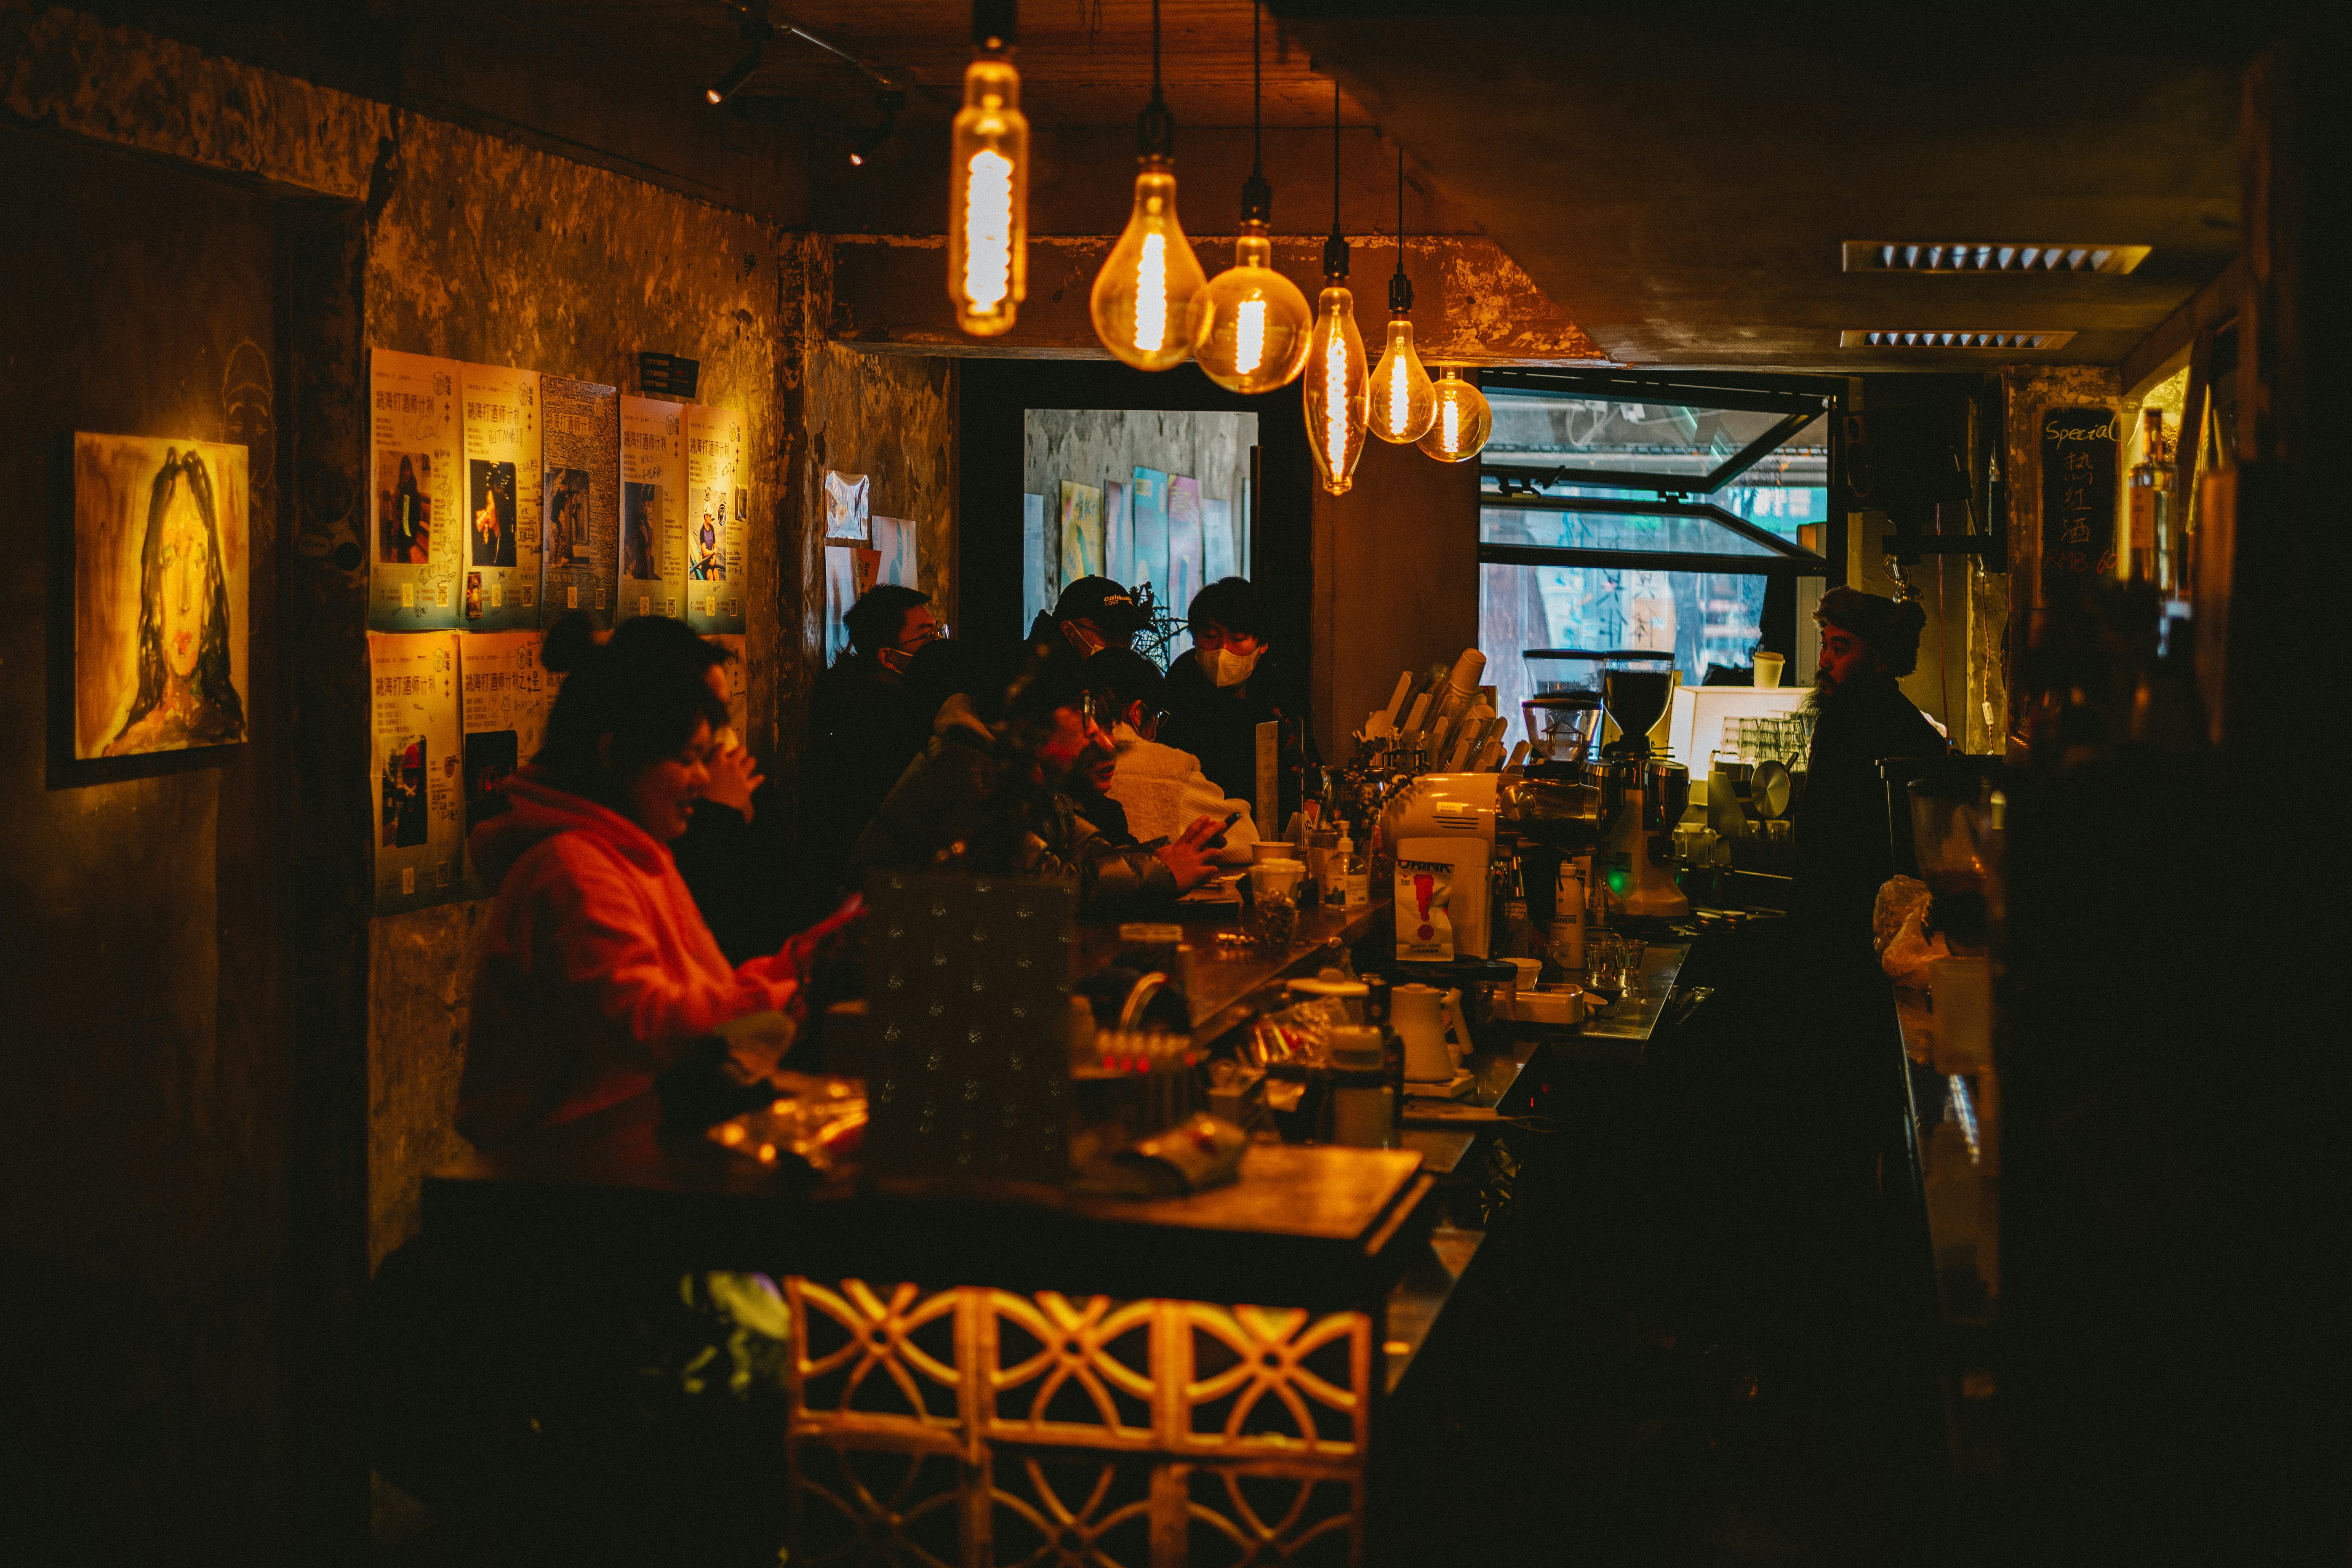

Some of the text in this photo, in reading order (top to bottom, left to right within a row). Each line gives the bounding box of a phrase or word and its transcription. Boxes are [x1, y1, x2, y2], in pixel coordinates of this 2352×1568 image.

[376, 390, 435, 416] 跳海打酒师计划
[468, 401, 520, 425] 跳海打酒师计划
[624, 431, 667, 453] 跳海打酒师计划
[2045, 415, 2120, 450] Special
[690, 437, 729, 459] 跳海打酒师计划
[2044, 548, 2118, 575] RMB 60
[376, 674, 436, 697] 跳海打酒师计划
[465, 671, 519, 693] 跳海打酒师计划
